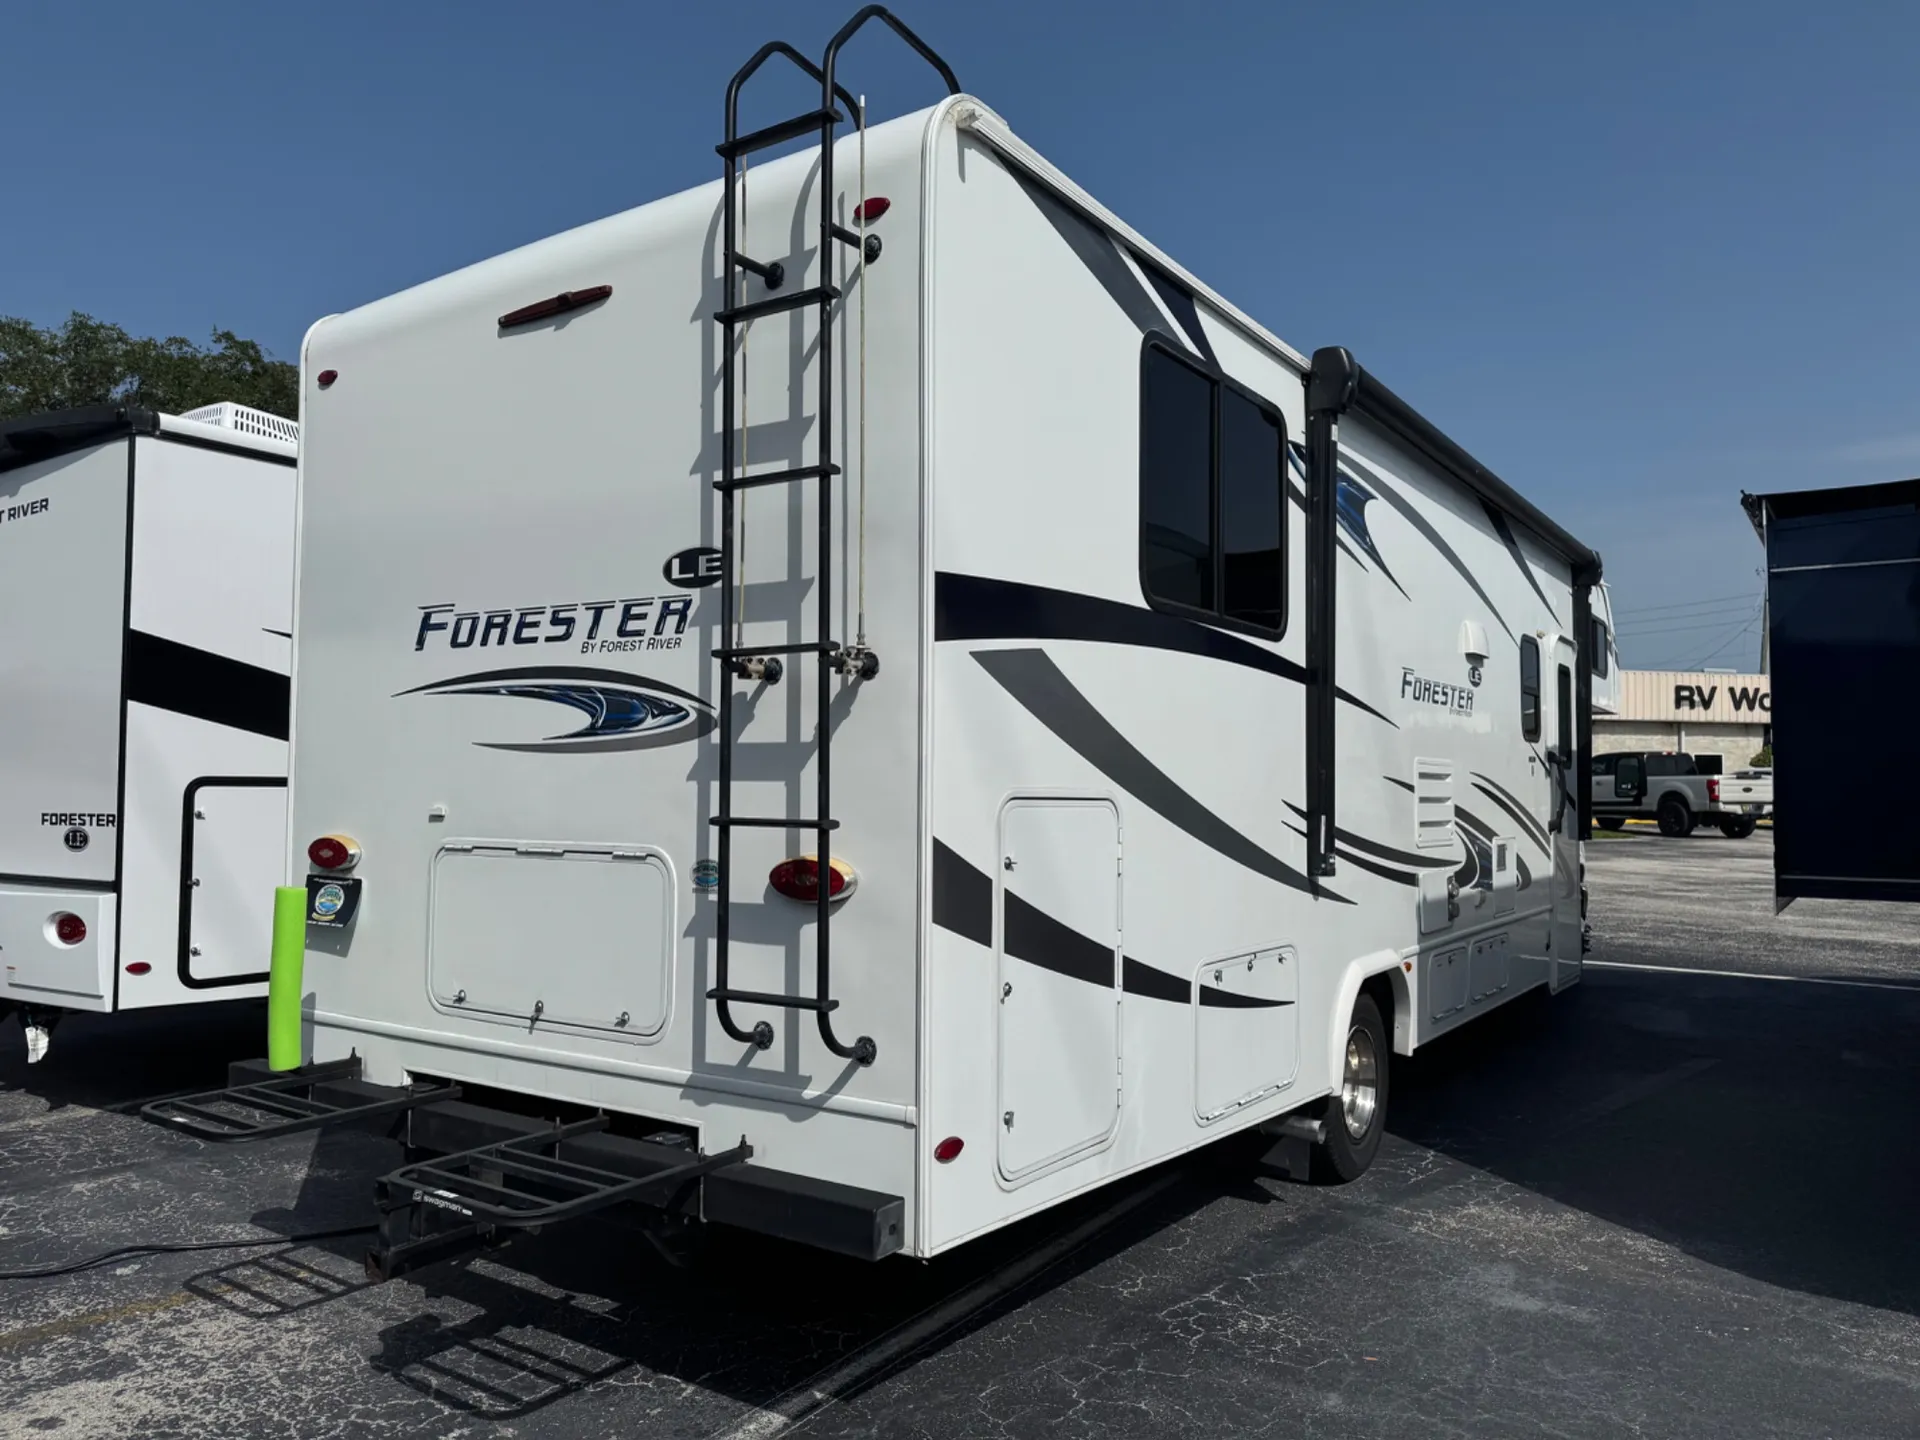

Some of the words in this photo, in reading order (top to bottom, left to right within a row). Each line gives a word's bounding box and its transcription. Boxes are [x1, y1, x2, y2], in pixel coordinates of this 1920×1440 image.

[7, 498, 49, 521] RIVER
[671, 553, 722, 579] LE
[414, 594, 694, 651] FORESTER
[581, 641, 597, 654] BY
[599, 639, 644, 653] FOREST
[646, 637, 682, 650] RIVER
[1470, 667, 1482, 683] LE
[1401, 666, 1475, 711] FORESTER
[1674, 684, 1717, 711] RV
[41, 812, 116, 827] FORESTER
[69, 832, 85, 847] LE
[423, 1195, 462, 1213] swagman
